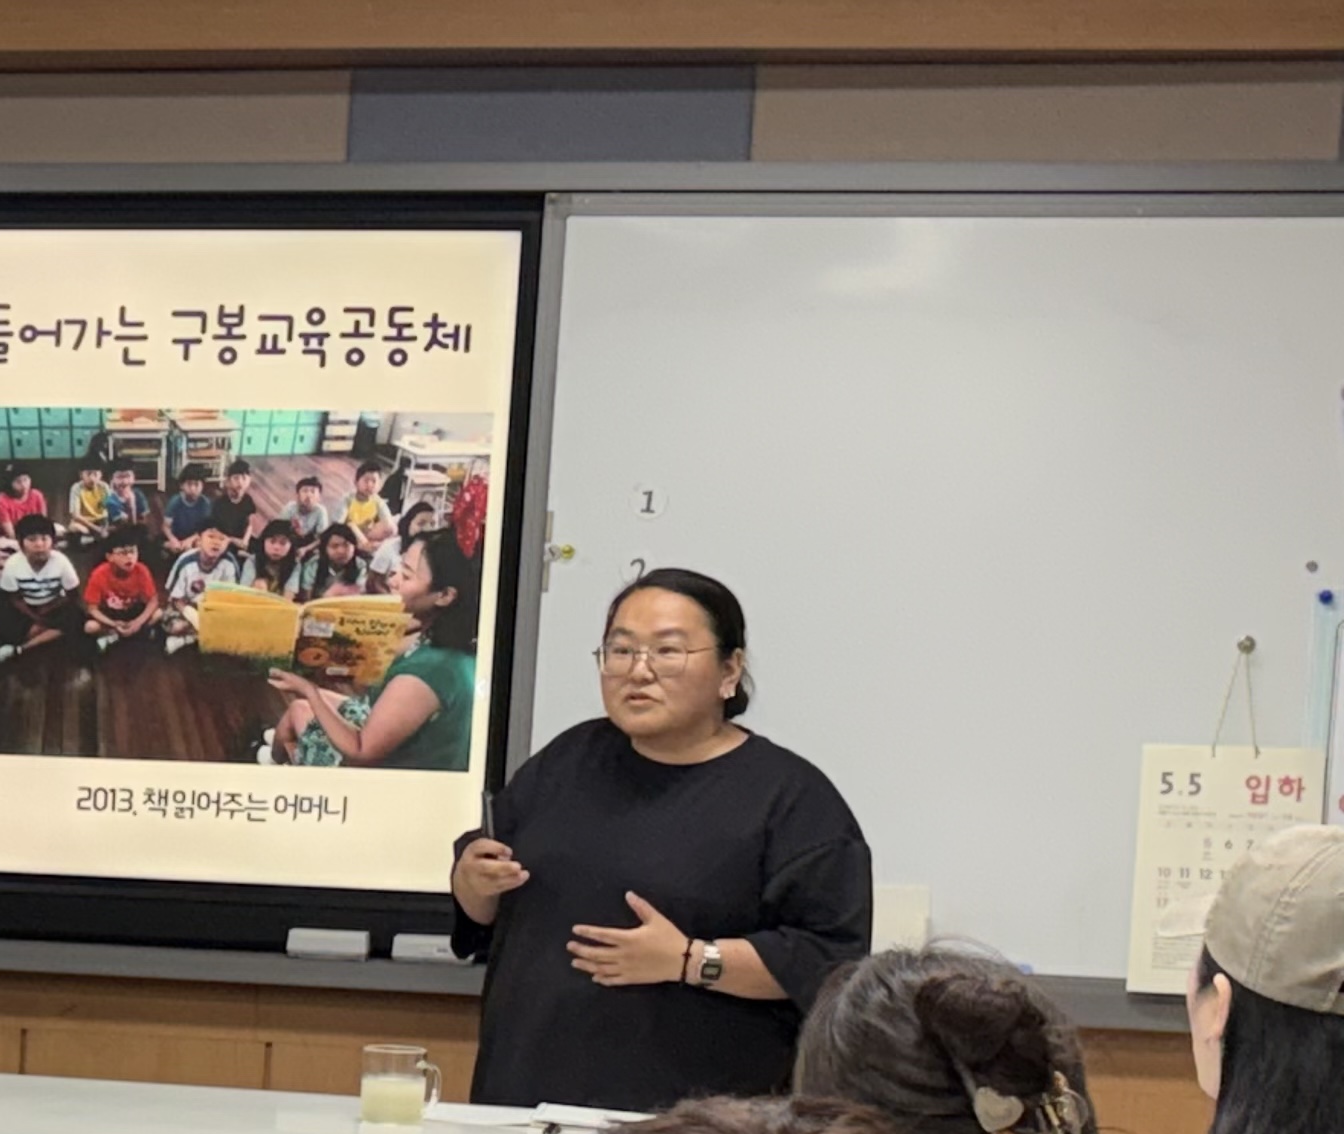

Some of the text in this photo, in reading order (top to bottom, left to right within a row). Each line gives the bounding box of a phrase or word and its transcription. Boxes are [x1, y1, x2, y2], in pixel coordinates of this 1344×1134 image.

[170, 303, 473, 369] 구봉교육공동체
[639, 489, 656, 514] 1
[1245, 774, 1307, 806] 입하
[273, 793, 349, 825] 어머니
